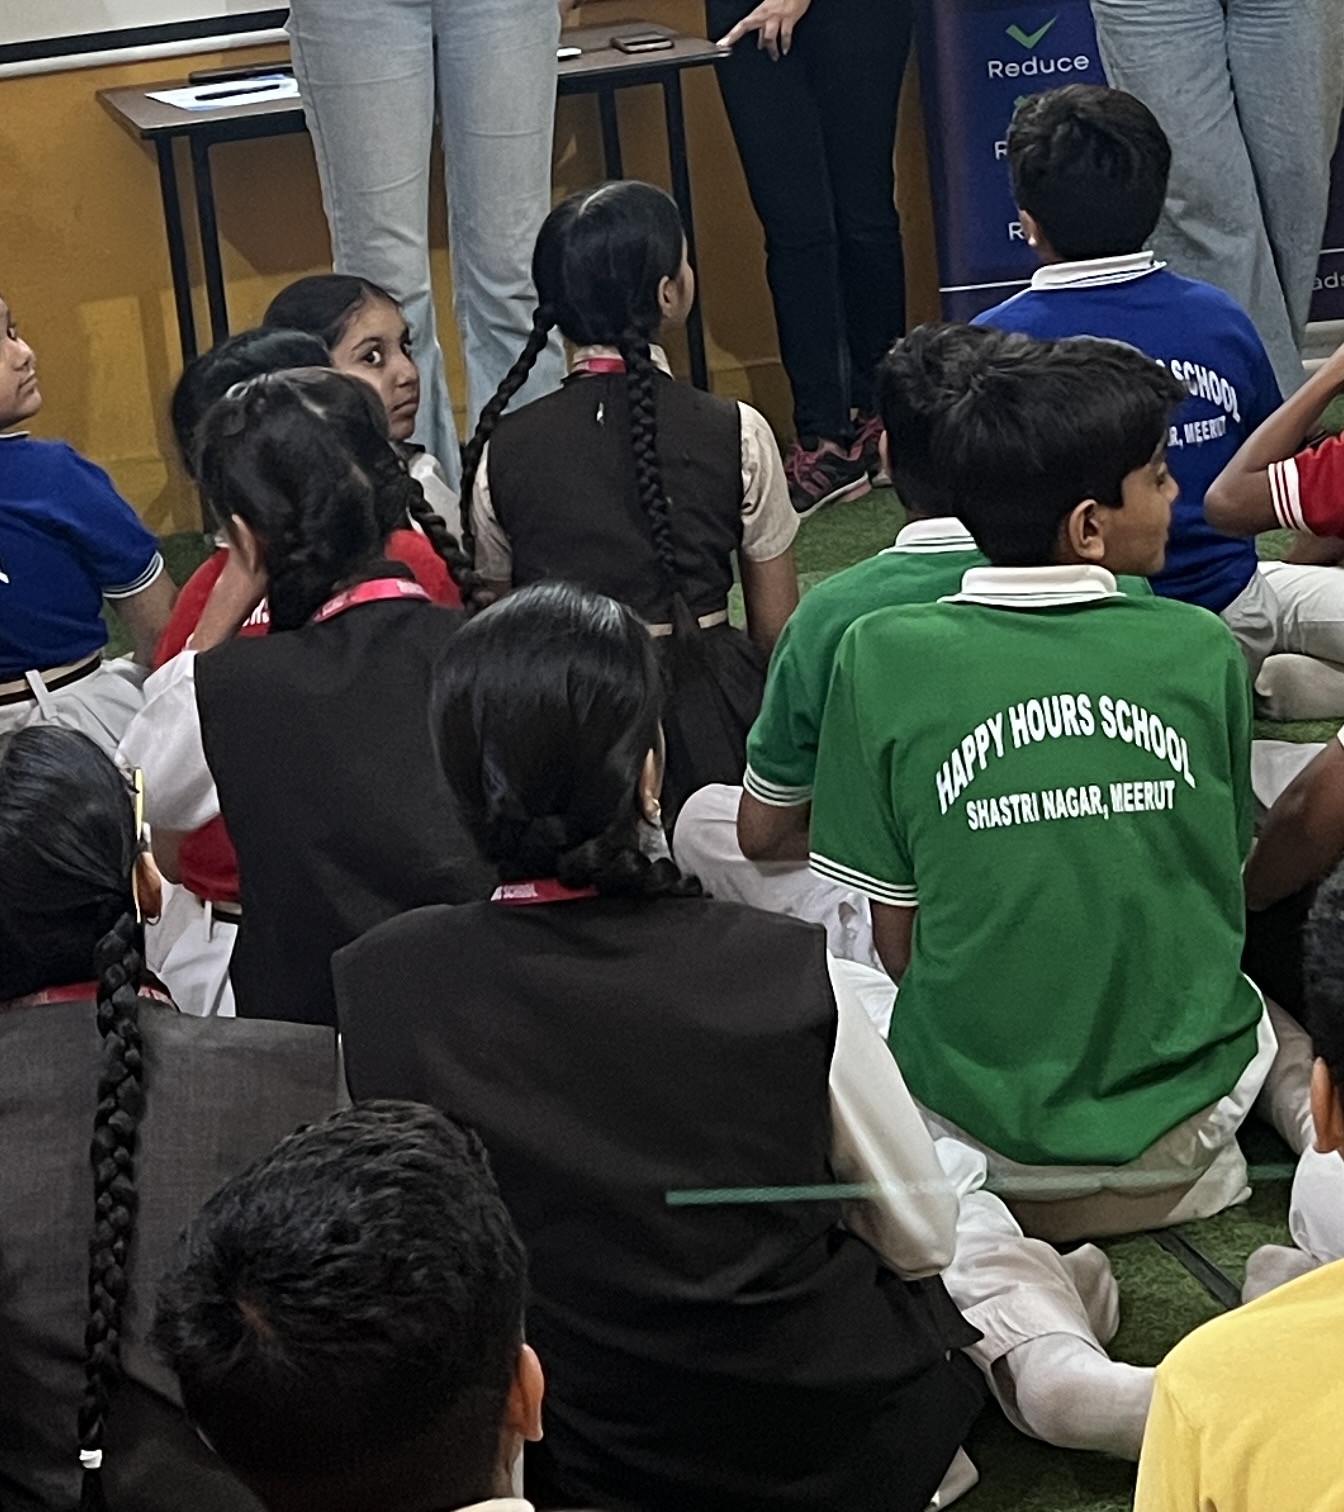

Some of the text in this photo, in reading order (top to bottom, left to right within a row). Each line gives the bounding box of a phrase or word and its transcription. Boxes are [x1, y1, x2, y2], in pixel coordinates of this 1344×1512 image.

[987, 54, 1090, 78] Reduce
[935, 693, 1197, 816] HAPPY HOURS SCHOOL
[966, 779, 1176, 831] SHASTRI NAGAR, MEERUT
